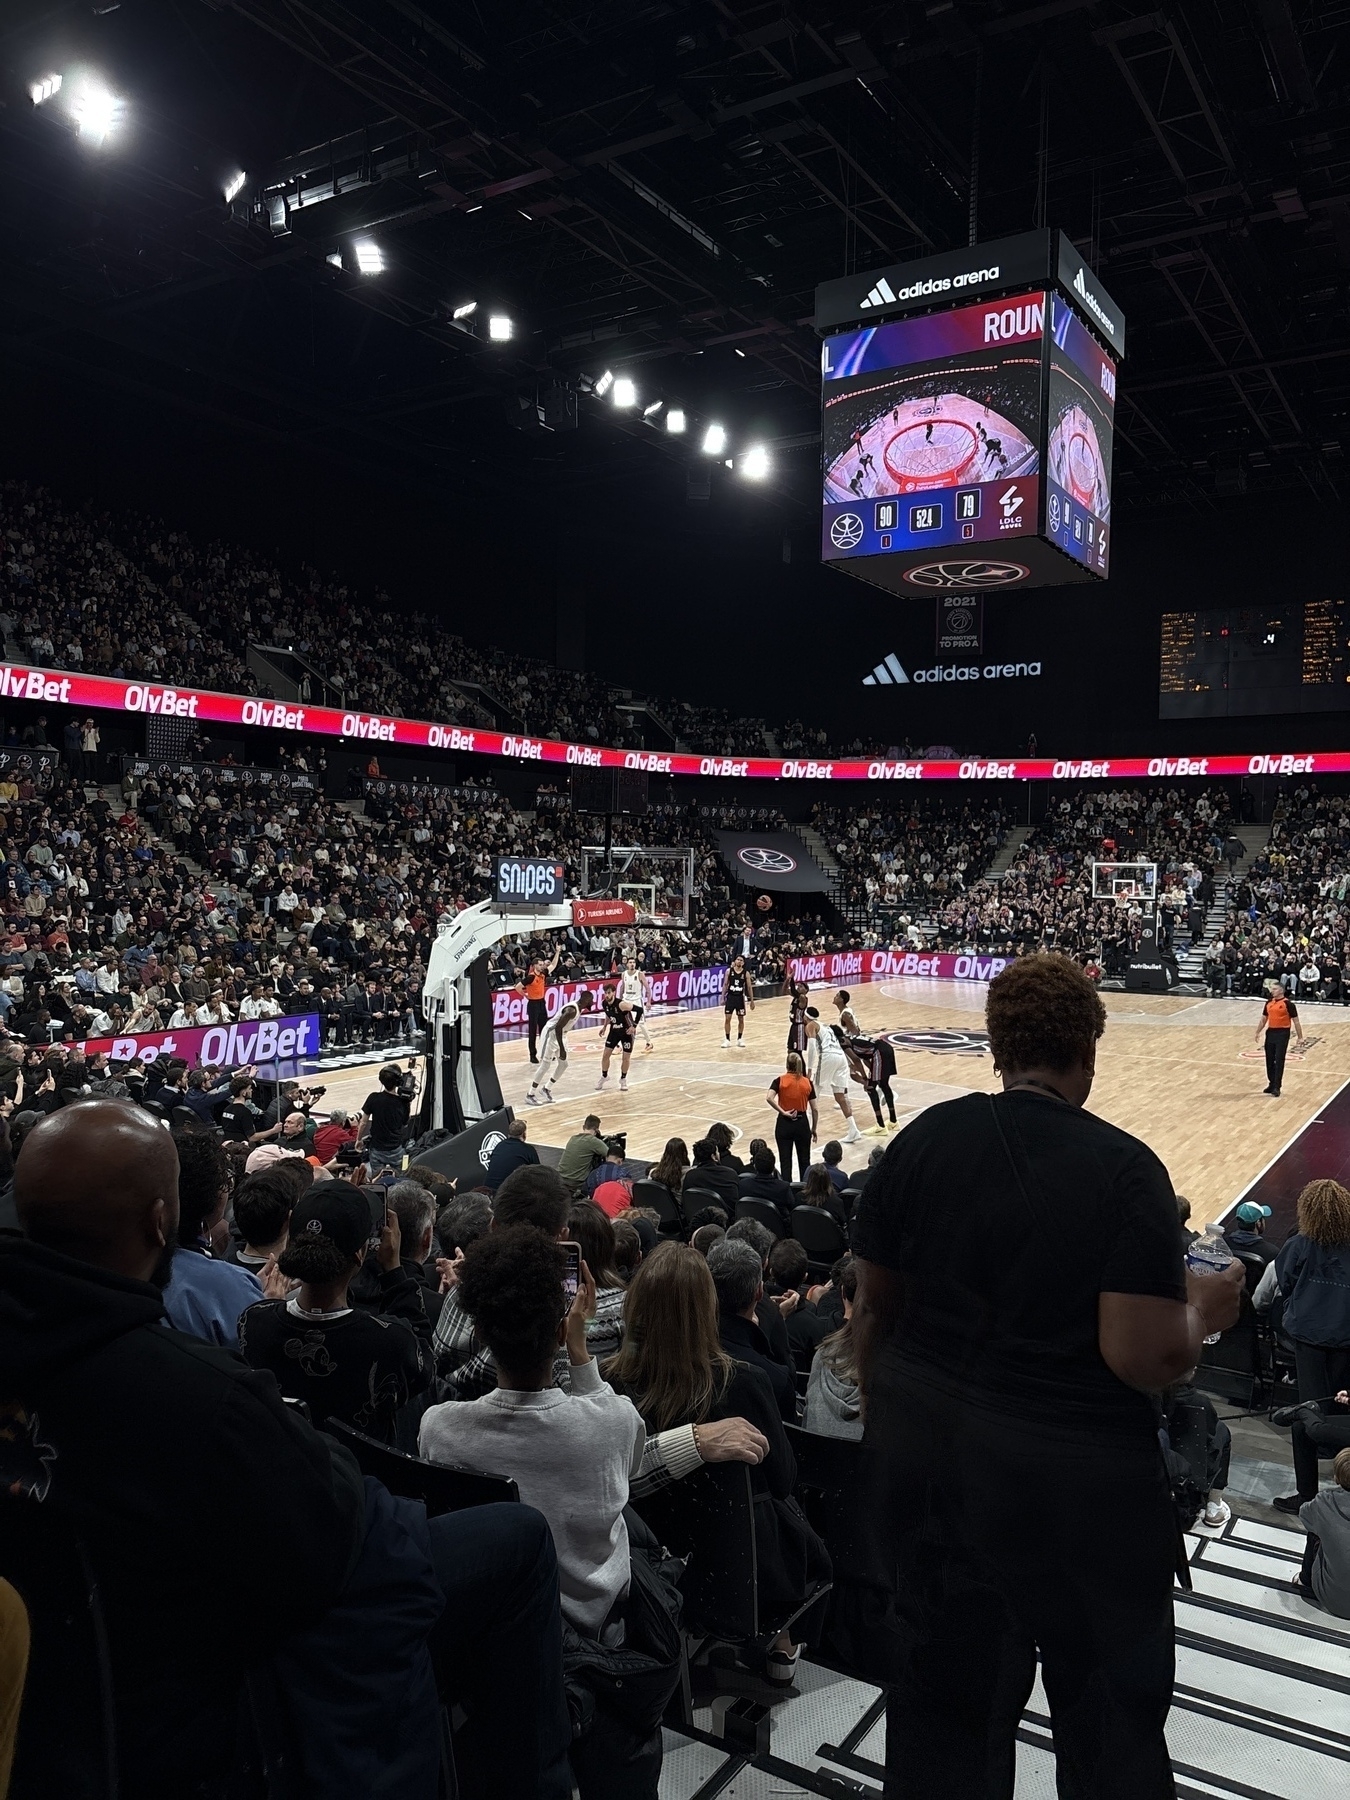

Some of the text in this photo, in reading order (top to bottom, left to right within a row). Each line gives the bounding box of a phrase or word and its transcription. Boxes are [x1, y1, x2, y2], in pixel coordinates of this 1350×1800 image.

[898, 266, 1000, 301] adidas arena
[1085, 291, 1114, 335] adidas arena
[880, 505, 893, 528] 90
[963, 494, 975, 517] 79
[999, 516, 1022, 526] LDLC
[943, 596, 977, 607] 2021
[953, 640, 971, 648] PRO
[913, 661, 1042, 684] adidas arena
[124, 684, 199, 719] OlyBet
[241, 700, 305, 732] OlyBet
[341, 713, 397, 743] OlyBet
[427, 725, 475, 752] OlyBet
[501, 736, 543, 760] OlyBet
[565, 745, 603, 767] OlyBet
[624, 752, 672, 773] OlyBet
[699, 758, 749, 777] OlyBet
[781, 760, 834, 779] OlyBet
[867, 761, 924, 780] OlyBet
[958, 761, 1016, 779] OlyBet
[1052, 760, 1111, 779] OlyBet
[1147, 757, 1209, 777] OlyBet
[1248, 754, 1315, 776] OlyBet
[499, 862, 556, 900] snipes
[605, 908, 623, 916] AIRLINES
[453, 935, 477, 963] SPALDING
[789, 957, 827, 982] OlyBet
[831, 953, 863, 976] OlyBet
[871, 951, 941, 976] OlyBet
[953, 956, 1007, 981] OlyB
[677, 968, 725, 998] OlyBet
[492, 991, 530, 1026] Bet
[200, 1019, 311, 1068] OlyBet
